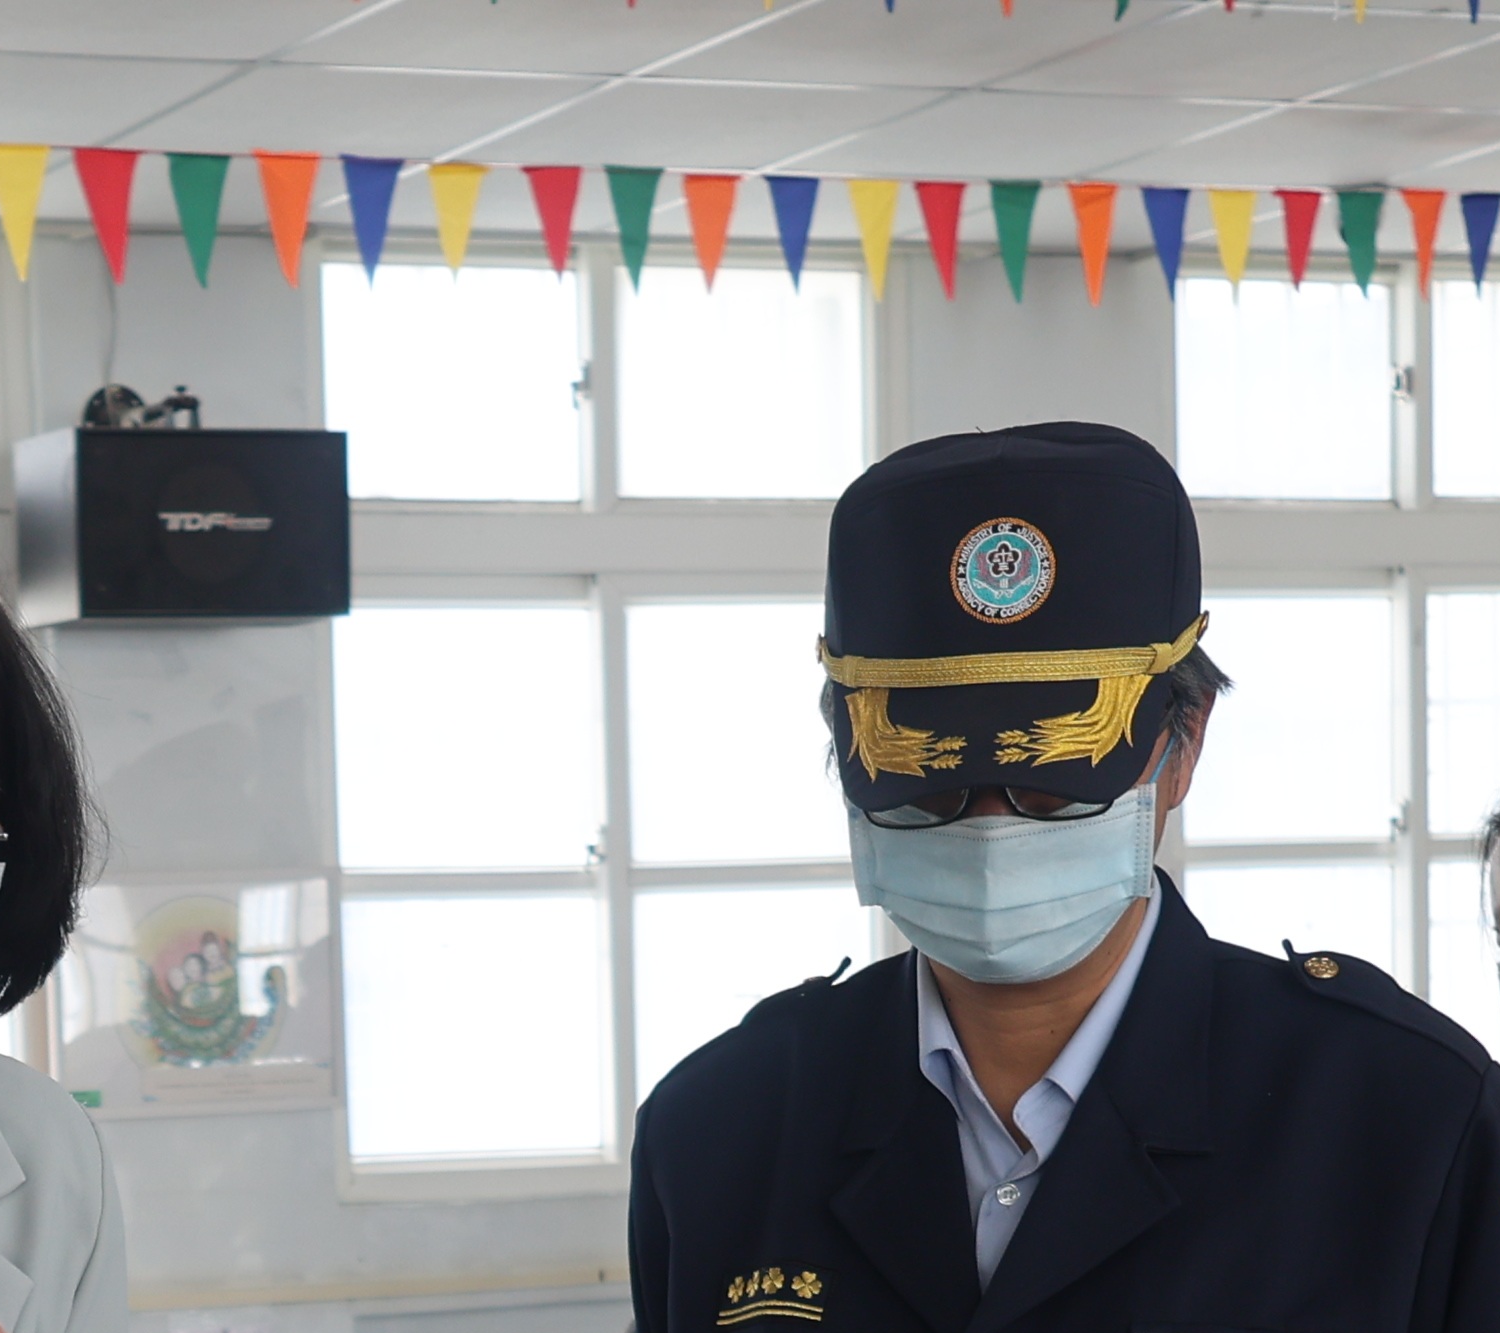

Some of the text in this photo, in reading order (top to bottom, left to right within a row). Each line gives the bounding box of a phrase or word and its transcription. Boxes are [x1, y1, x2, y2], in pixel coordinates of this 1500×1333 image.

[958, 522, 1050, 564] MINISTRY OF JUSTICE
[957, 568, 1051, 618] AGENCY OF CORRECTIONS
